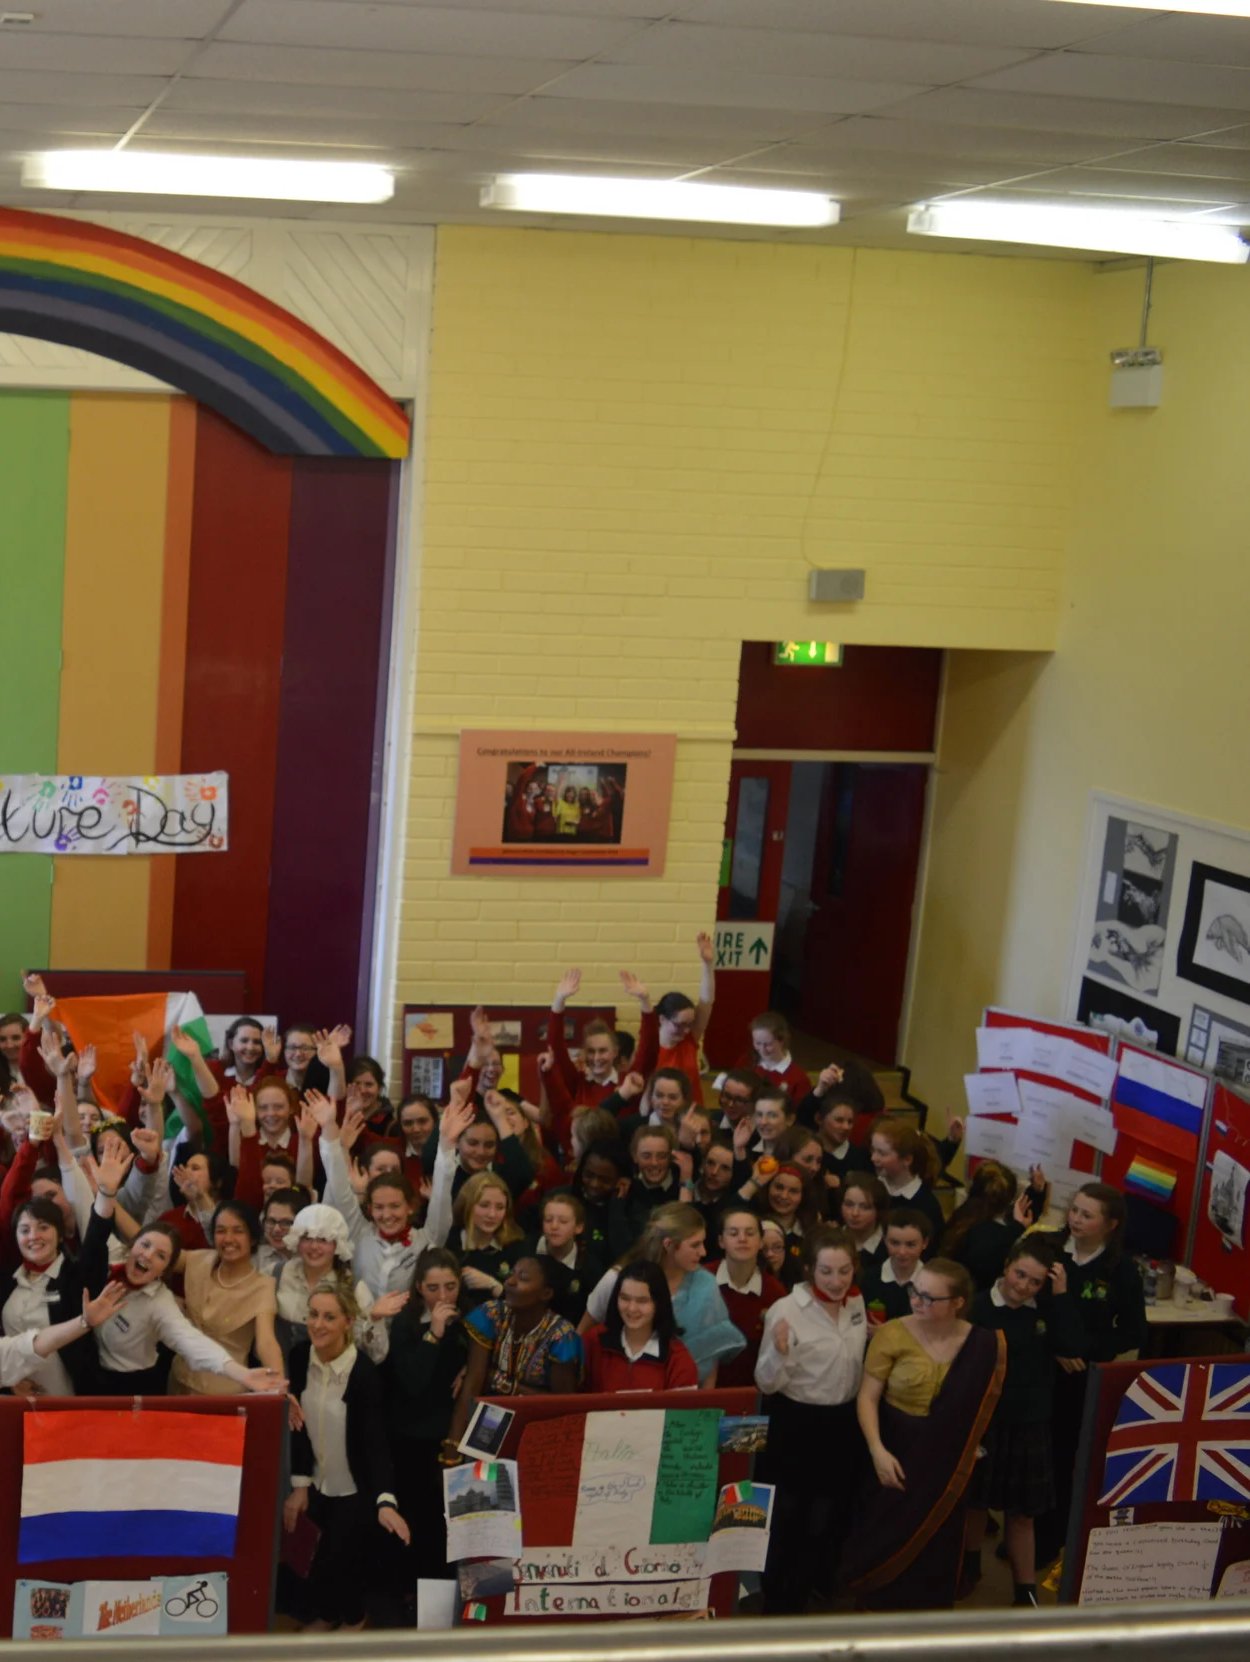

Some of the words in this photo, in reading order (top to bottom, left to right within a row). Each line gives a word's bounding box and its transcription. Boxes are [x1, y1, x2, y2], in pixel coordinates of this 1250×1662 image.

[106, 785, 215, 850] Day
[715, 931, 745, 949] IRE
[715, 951, 743, 967] XIT
